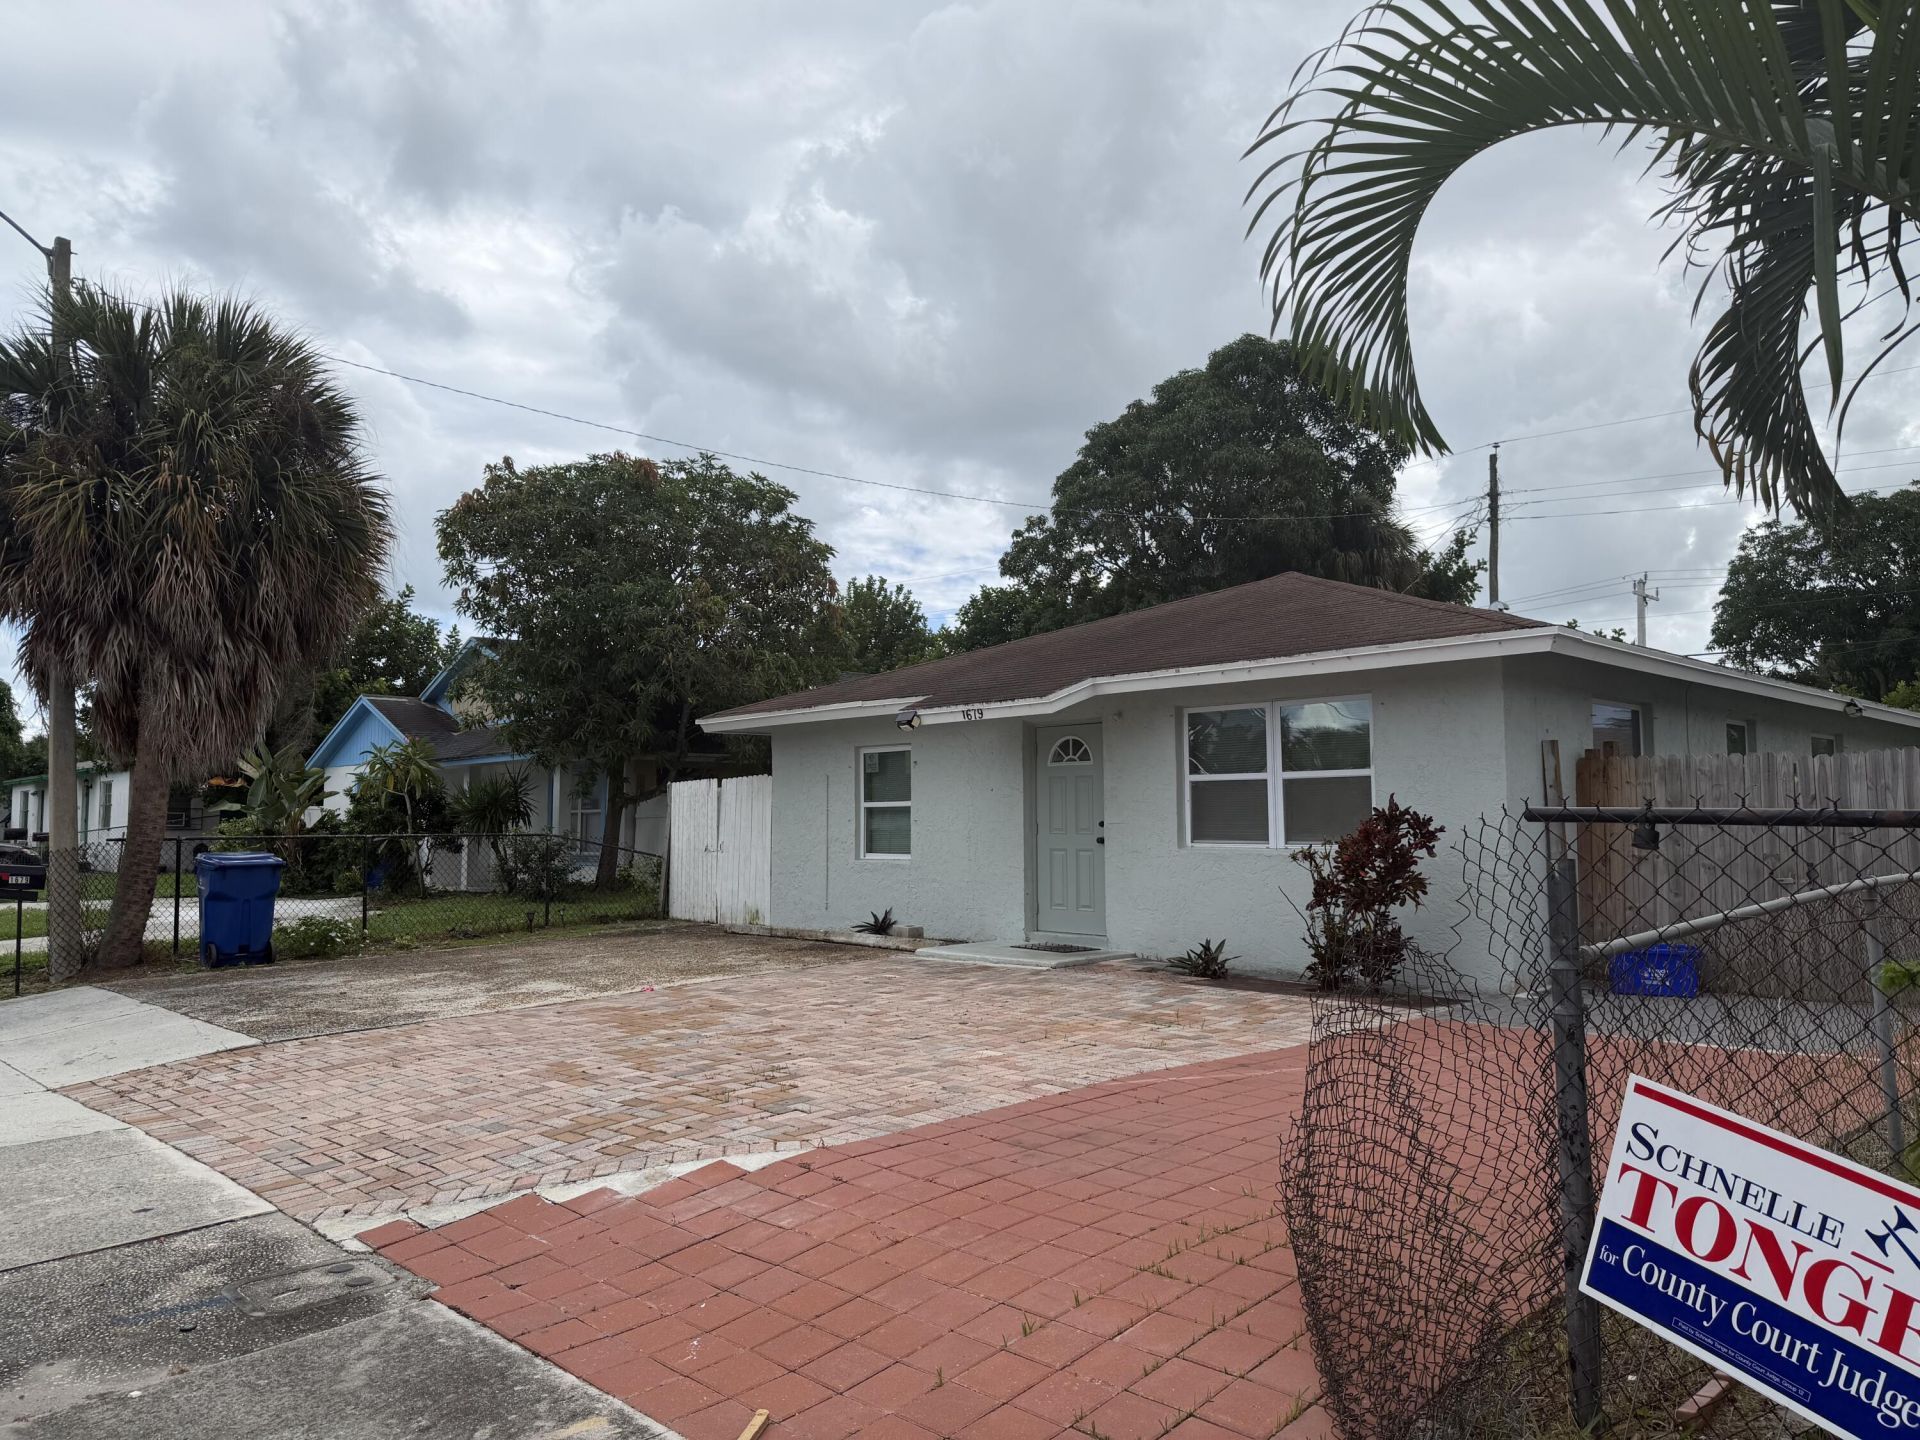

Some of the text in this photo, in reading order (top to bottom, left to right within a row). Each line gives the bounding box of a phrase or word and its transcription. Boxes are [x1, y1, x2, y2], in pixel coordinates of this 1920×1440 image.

[961, 708, 984, 721] 1679
[1625, 1122, 1845, 1249] SCHNELLE
[1599, 1244, 1920, 1429] for County Court Judge
